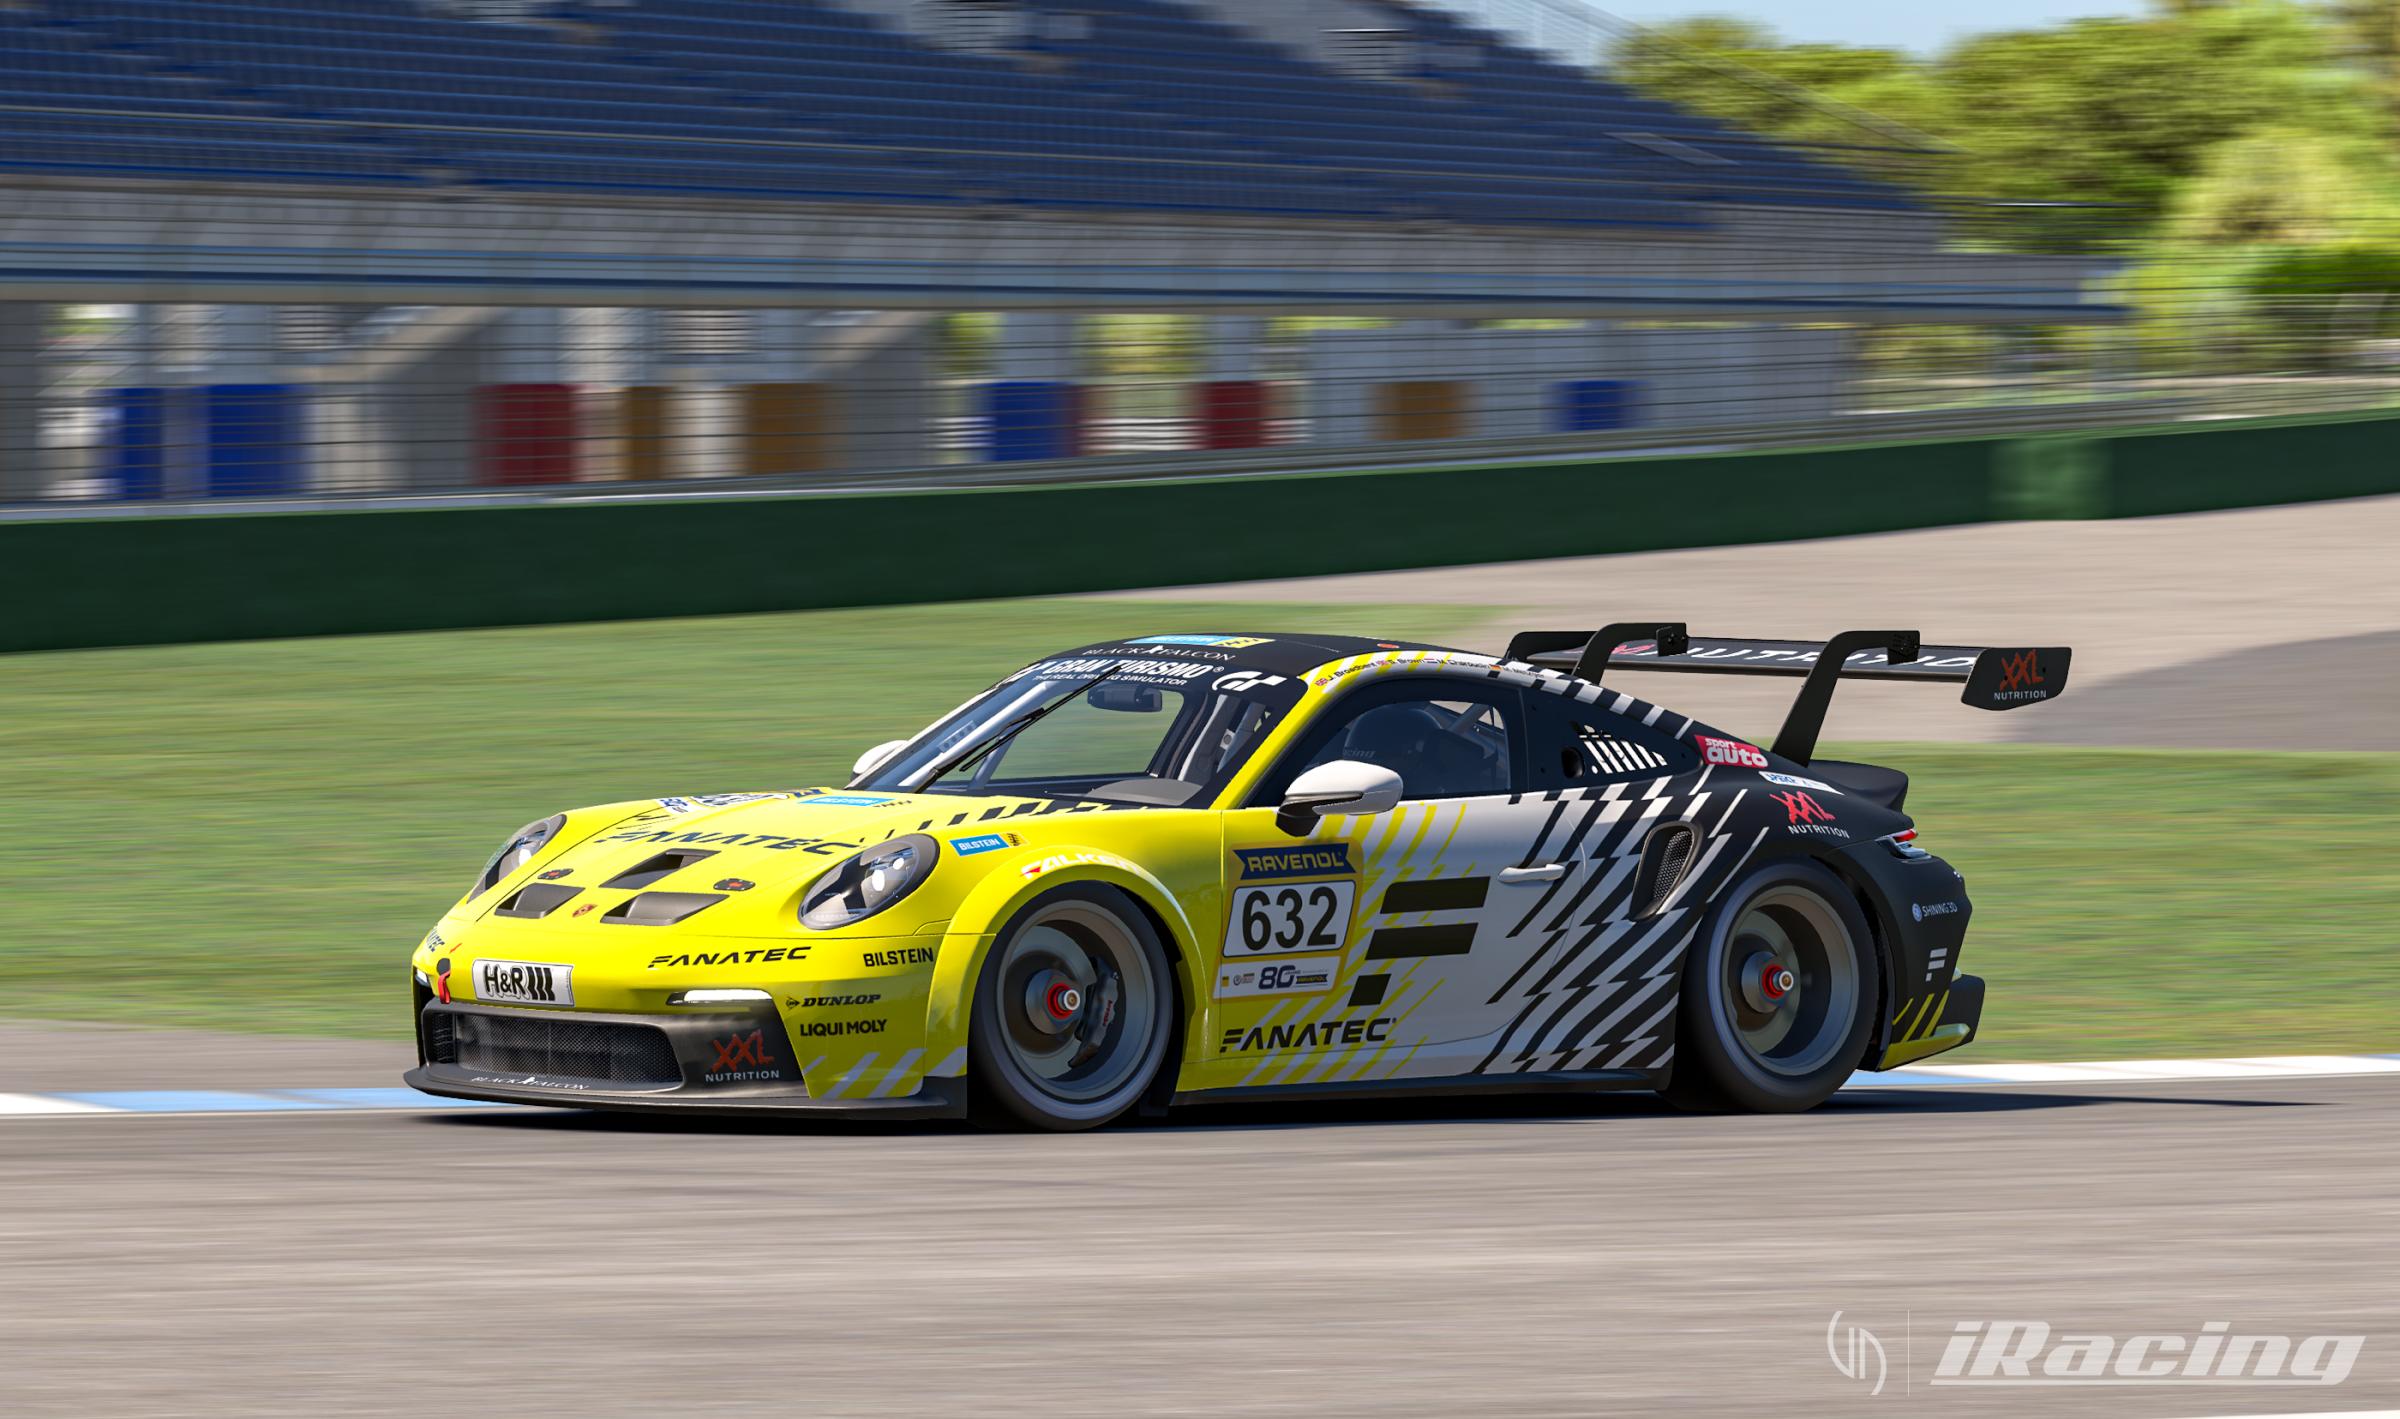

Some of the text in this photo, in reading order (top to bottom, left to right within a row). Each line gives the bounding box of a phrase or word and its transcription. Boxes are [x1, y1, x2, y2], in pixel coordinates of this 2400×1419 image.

[1082, 647, 1236, 661] BLACK FALCON
[1042, 659, 1115, 675] GRAN
[2000, 649, 2044, 690] XXL
[1120, 674, 1187, 686] SIMULATOR
[1994, 689, 2047, 700] NUTRITION
[1704, 737, 1737, 750] sport
[1706, 746, 1768, 768] auto
[1769, 790, 1836, 824] XXL
[1787, 825, 1850, 839] NUTRITION
[594, 831, 860, 855] FANATEC
[957, 838, 1001, 851] BILSTEIN
[1247, 852, 1345, 873] RAVENOL
[1242, 886, 1338, 951] 632
[647, 946, 813, 968] FANATEC
[863, 947, 935, 968] BILSTEIN
[484, 964, 528, 998] H&R
[801, 993, 882, 1008] DUNLOP
[800, 1019, 888, 1037] LIQUI MOLY
[1219, 1017, 1391, 1054] FANATEC
[711, 1029, 775, 1073] XXL
[705, 1069, 780, 1083] NUTRITION
